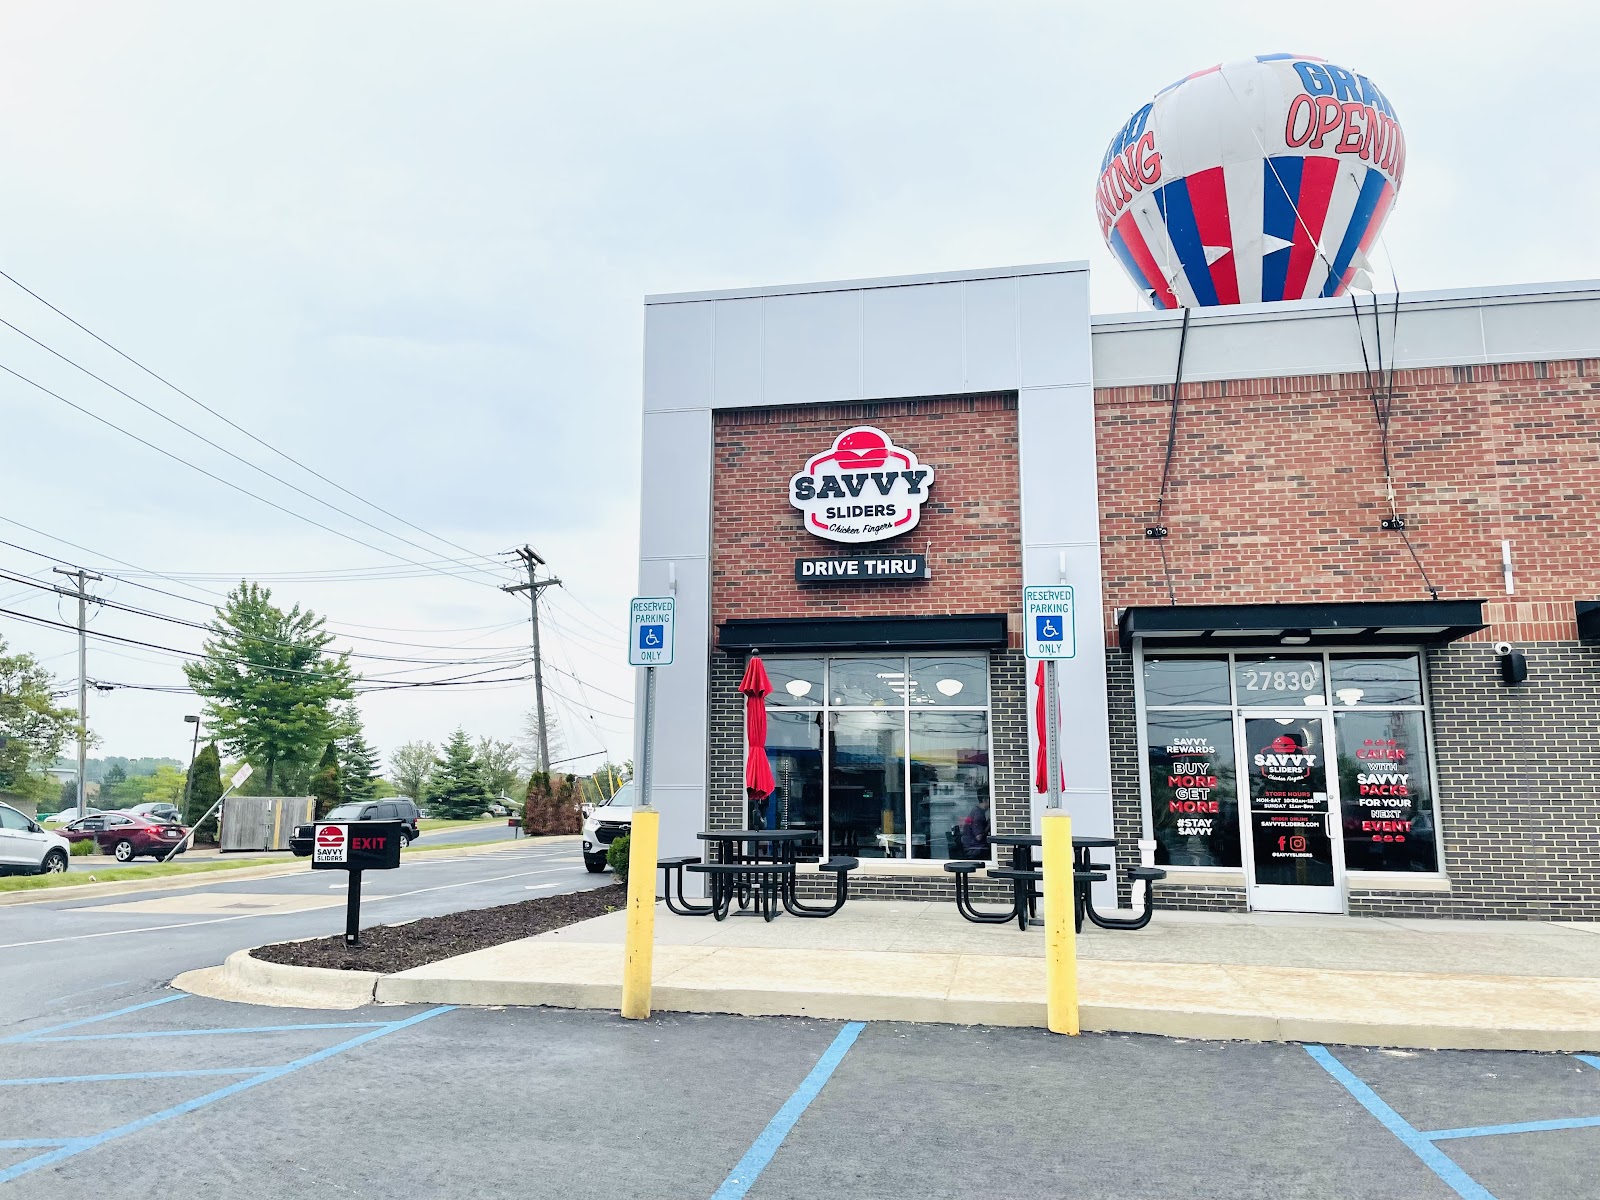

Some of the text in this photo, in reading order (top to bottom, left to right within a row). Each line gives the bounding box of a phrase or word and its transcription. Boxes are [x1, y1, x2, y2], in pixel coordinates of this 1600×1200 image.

[1285, 93, 1406, 192] OPENIN
[795, 470, 927, 500] SAVVY
[826, 504, 896, 519] SLIDERS
[829, 522, 893, 535] Chicken Fingers
[802, 559, 917, 575] DRIVE THRU
[1027, 591, 1071, 601] RESERVED
[633, 602, 672, 611] RESERVED
[1030, 603, 1069, 613] PARKING
[635, 614, 670, 623] PARKING
[1039, 643, 1062, 653] ONLY
[641, 651, 661, 660] ONLY
[1246, 671, 1315, 691] 27830
[1173, 738, 1207, 746] SAVVY
[1356, 749, 1405, 760] CATER
[1254, 754, 1317, 767] SAVVY
[1173, 762, 1210, 775] BUY
[1367, 763, 1398, 771] WITH
[1168, 775, 1217, 787] MORE
[1357, 774, 1409, 785] SAVVY
[1175, 787, 1210, 800] GET
[1360, 785, 1408, 795] PACKS
[1169, 801, 1219, 813] MORE
[1359, 799, 1412, 807] FOR YOUR
[1371, 810, 1401, 818] NEXT
[1177, 818, 1212, 828] #STAY
[1362, 821, 1412, 832] EVENT
[1178, 827, 1213, 836] SAVVY
[352, 838, 386, 849] EXIT
